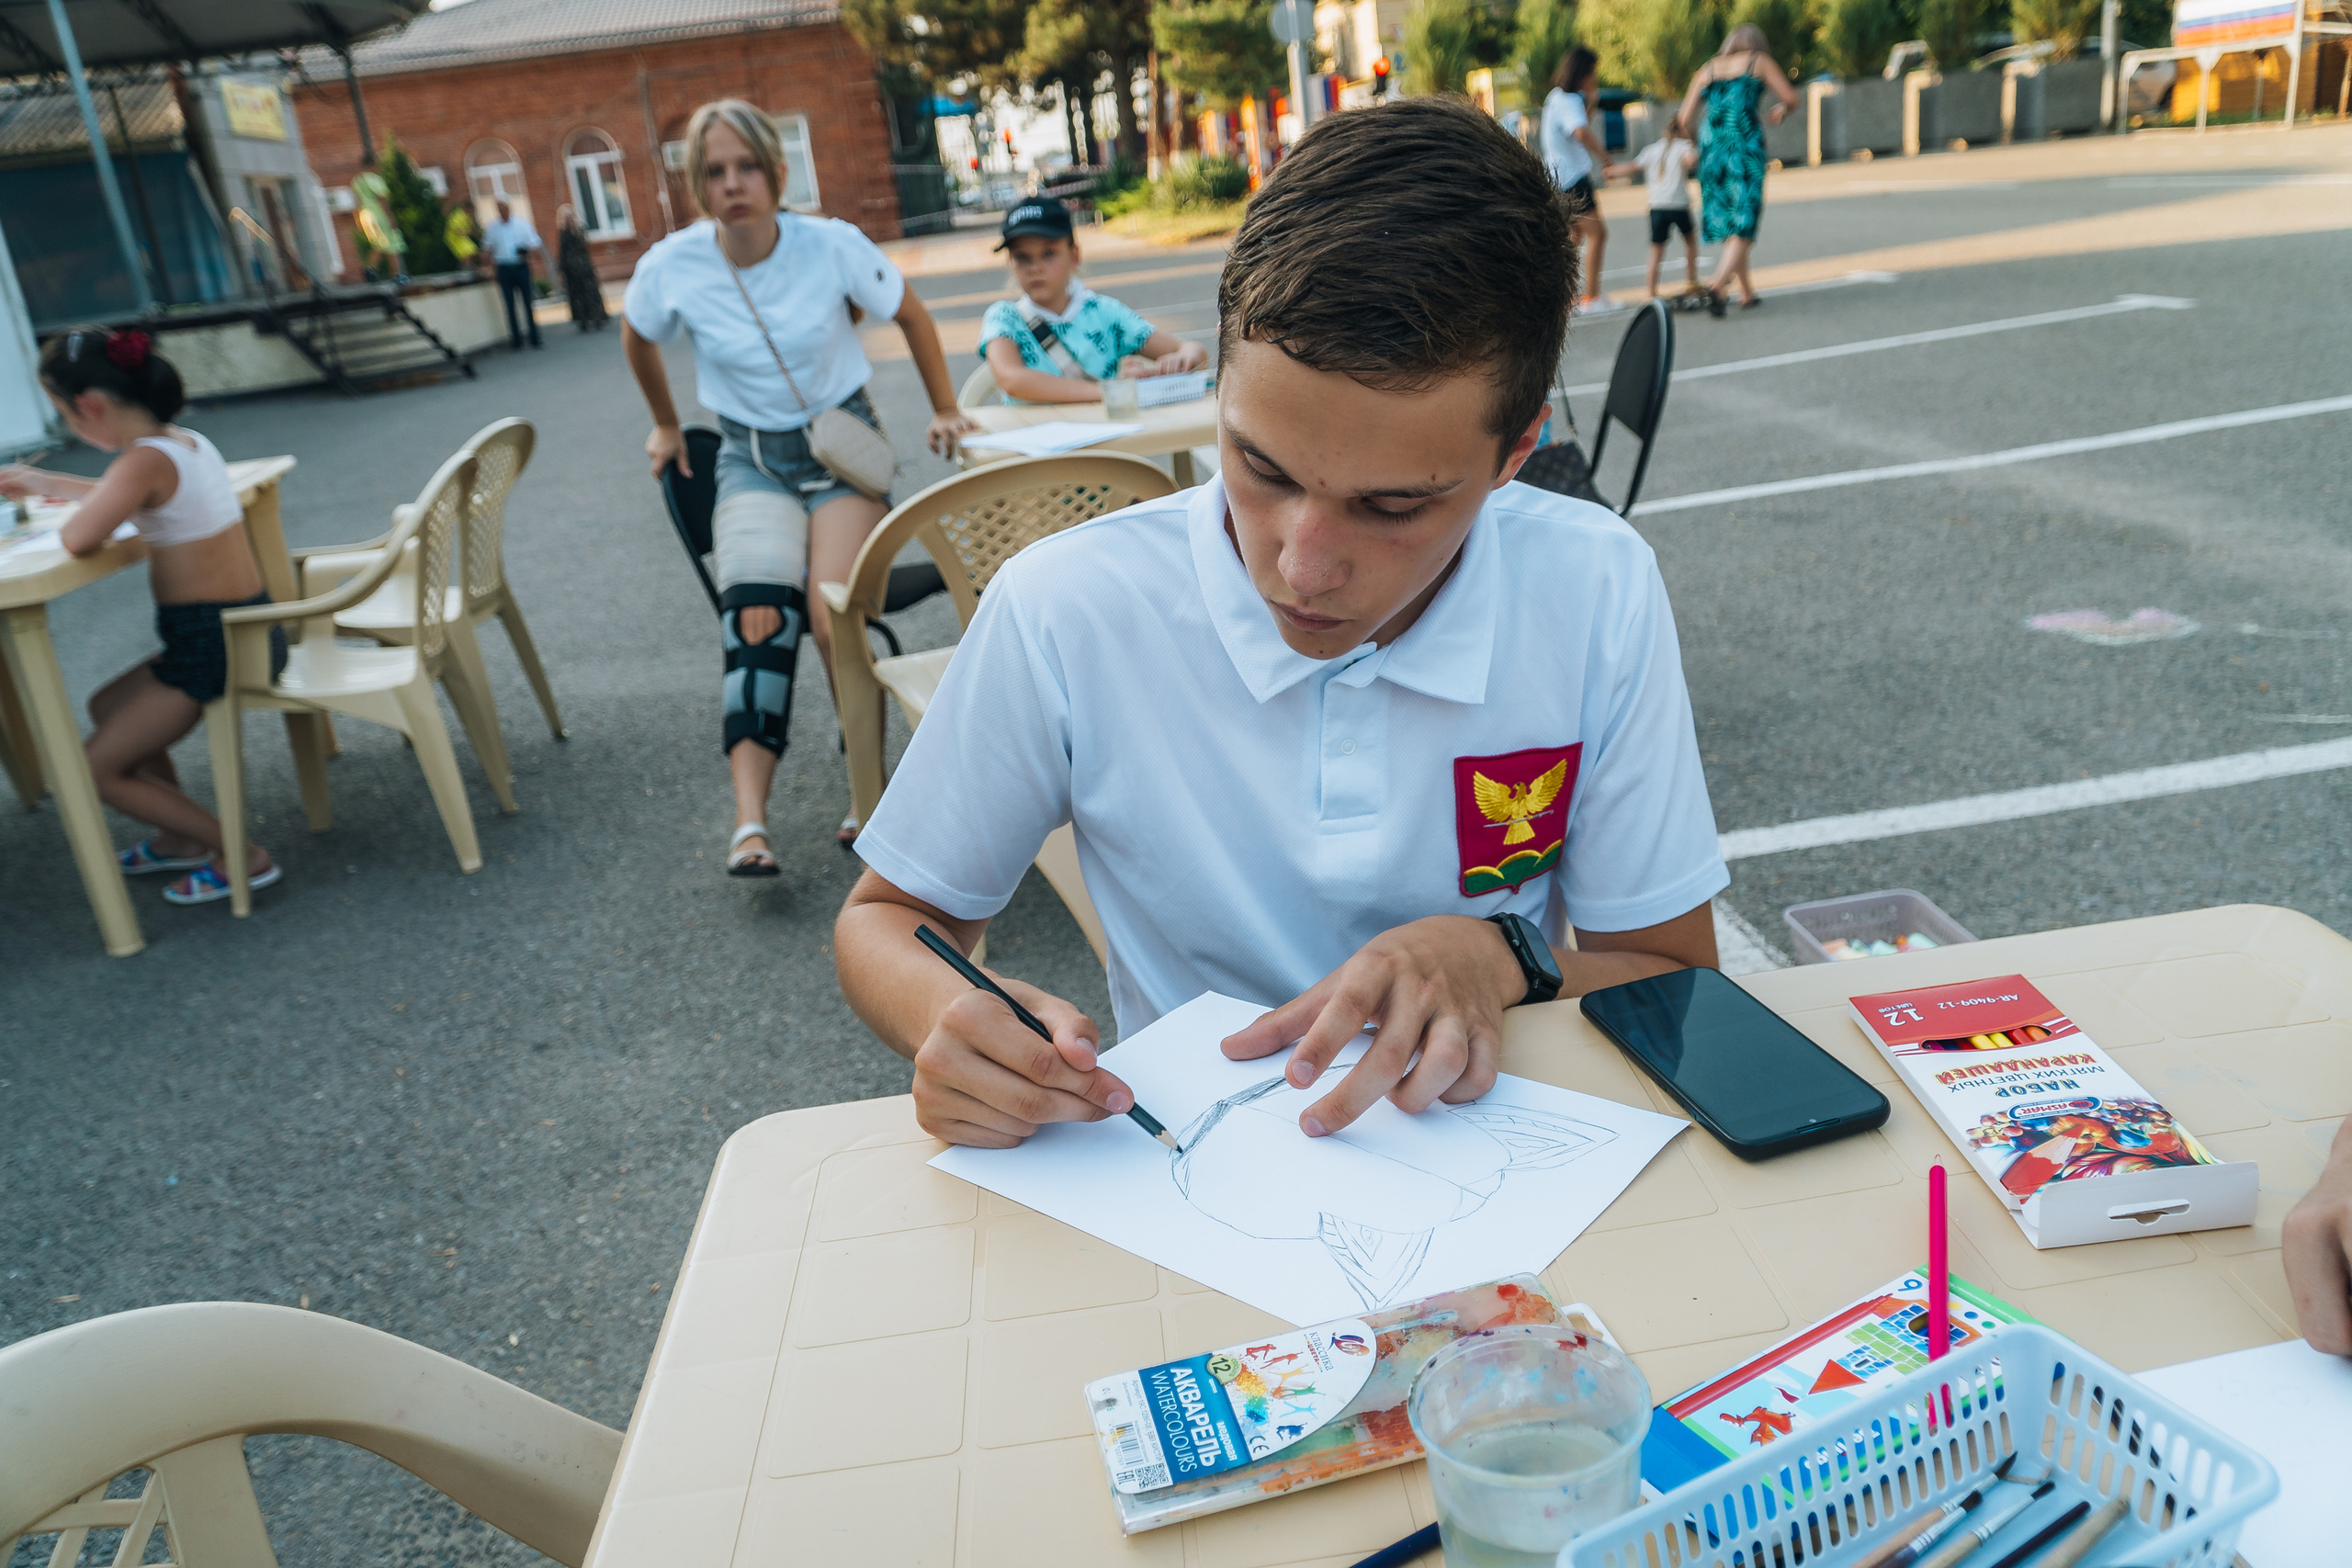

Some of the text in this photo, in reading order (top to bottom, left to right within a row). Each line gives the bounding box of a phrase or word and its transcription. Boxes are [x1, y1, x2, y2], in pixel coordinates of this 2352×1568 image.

[1878, 1002, 1914, 1013] ЦВЕТОВ
[1937, 994, 2018, 1010] AR-9409-12
[1883, 1008, 1925, 1026] 12
[1934, 1053, 2098, 1085] КАРАНДАШЕЙ
[1950, 1066, 2106, 1093] МЯГКИХ ЦВЕТНЫХ
[1995, 1078, 2081, 1098] НАБОР
[1211, 1357, 1231, 1374] 12
[1151, 1371, 1197, 1472] WATERCOLOURS
[1170, 1368, 1222, 1467] АКВАРЕЛЬ
[1216, 1421, 1238, 1461] медовая
